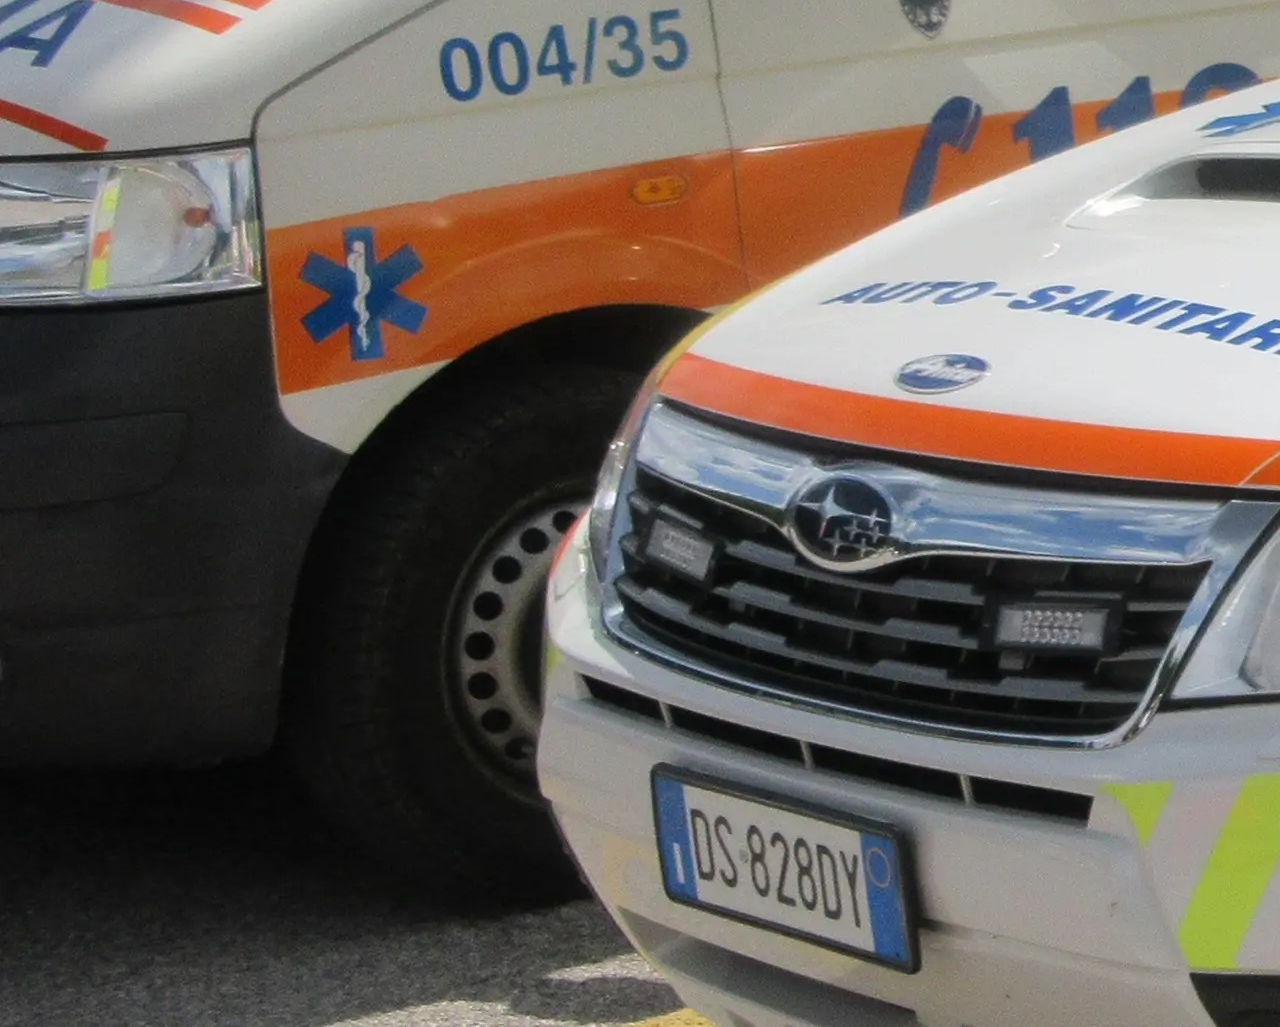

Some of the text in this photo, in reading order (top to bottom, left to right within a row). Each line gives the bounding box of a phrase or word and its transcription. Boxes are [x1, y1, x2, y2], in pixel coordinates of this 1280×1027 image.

[439, 8, 690, 102] 004/35
[690, 808, 738, 888] DS
[746, 824, 862, 929] 828DY
